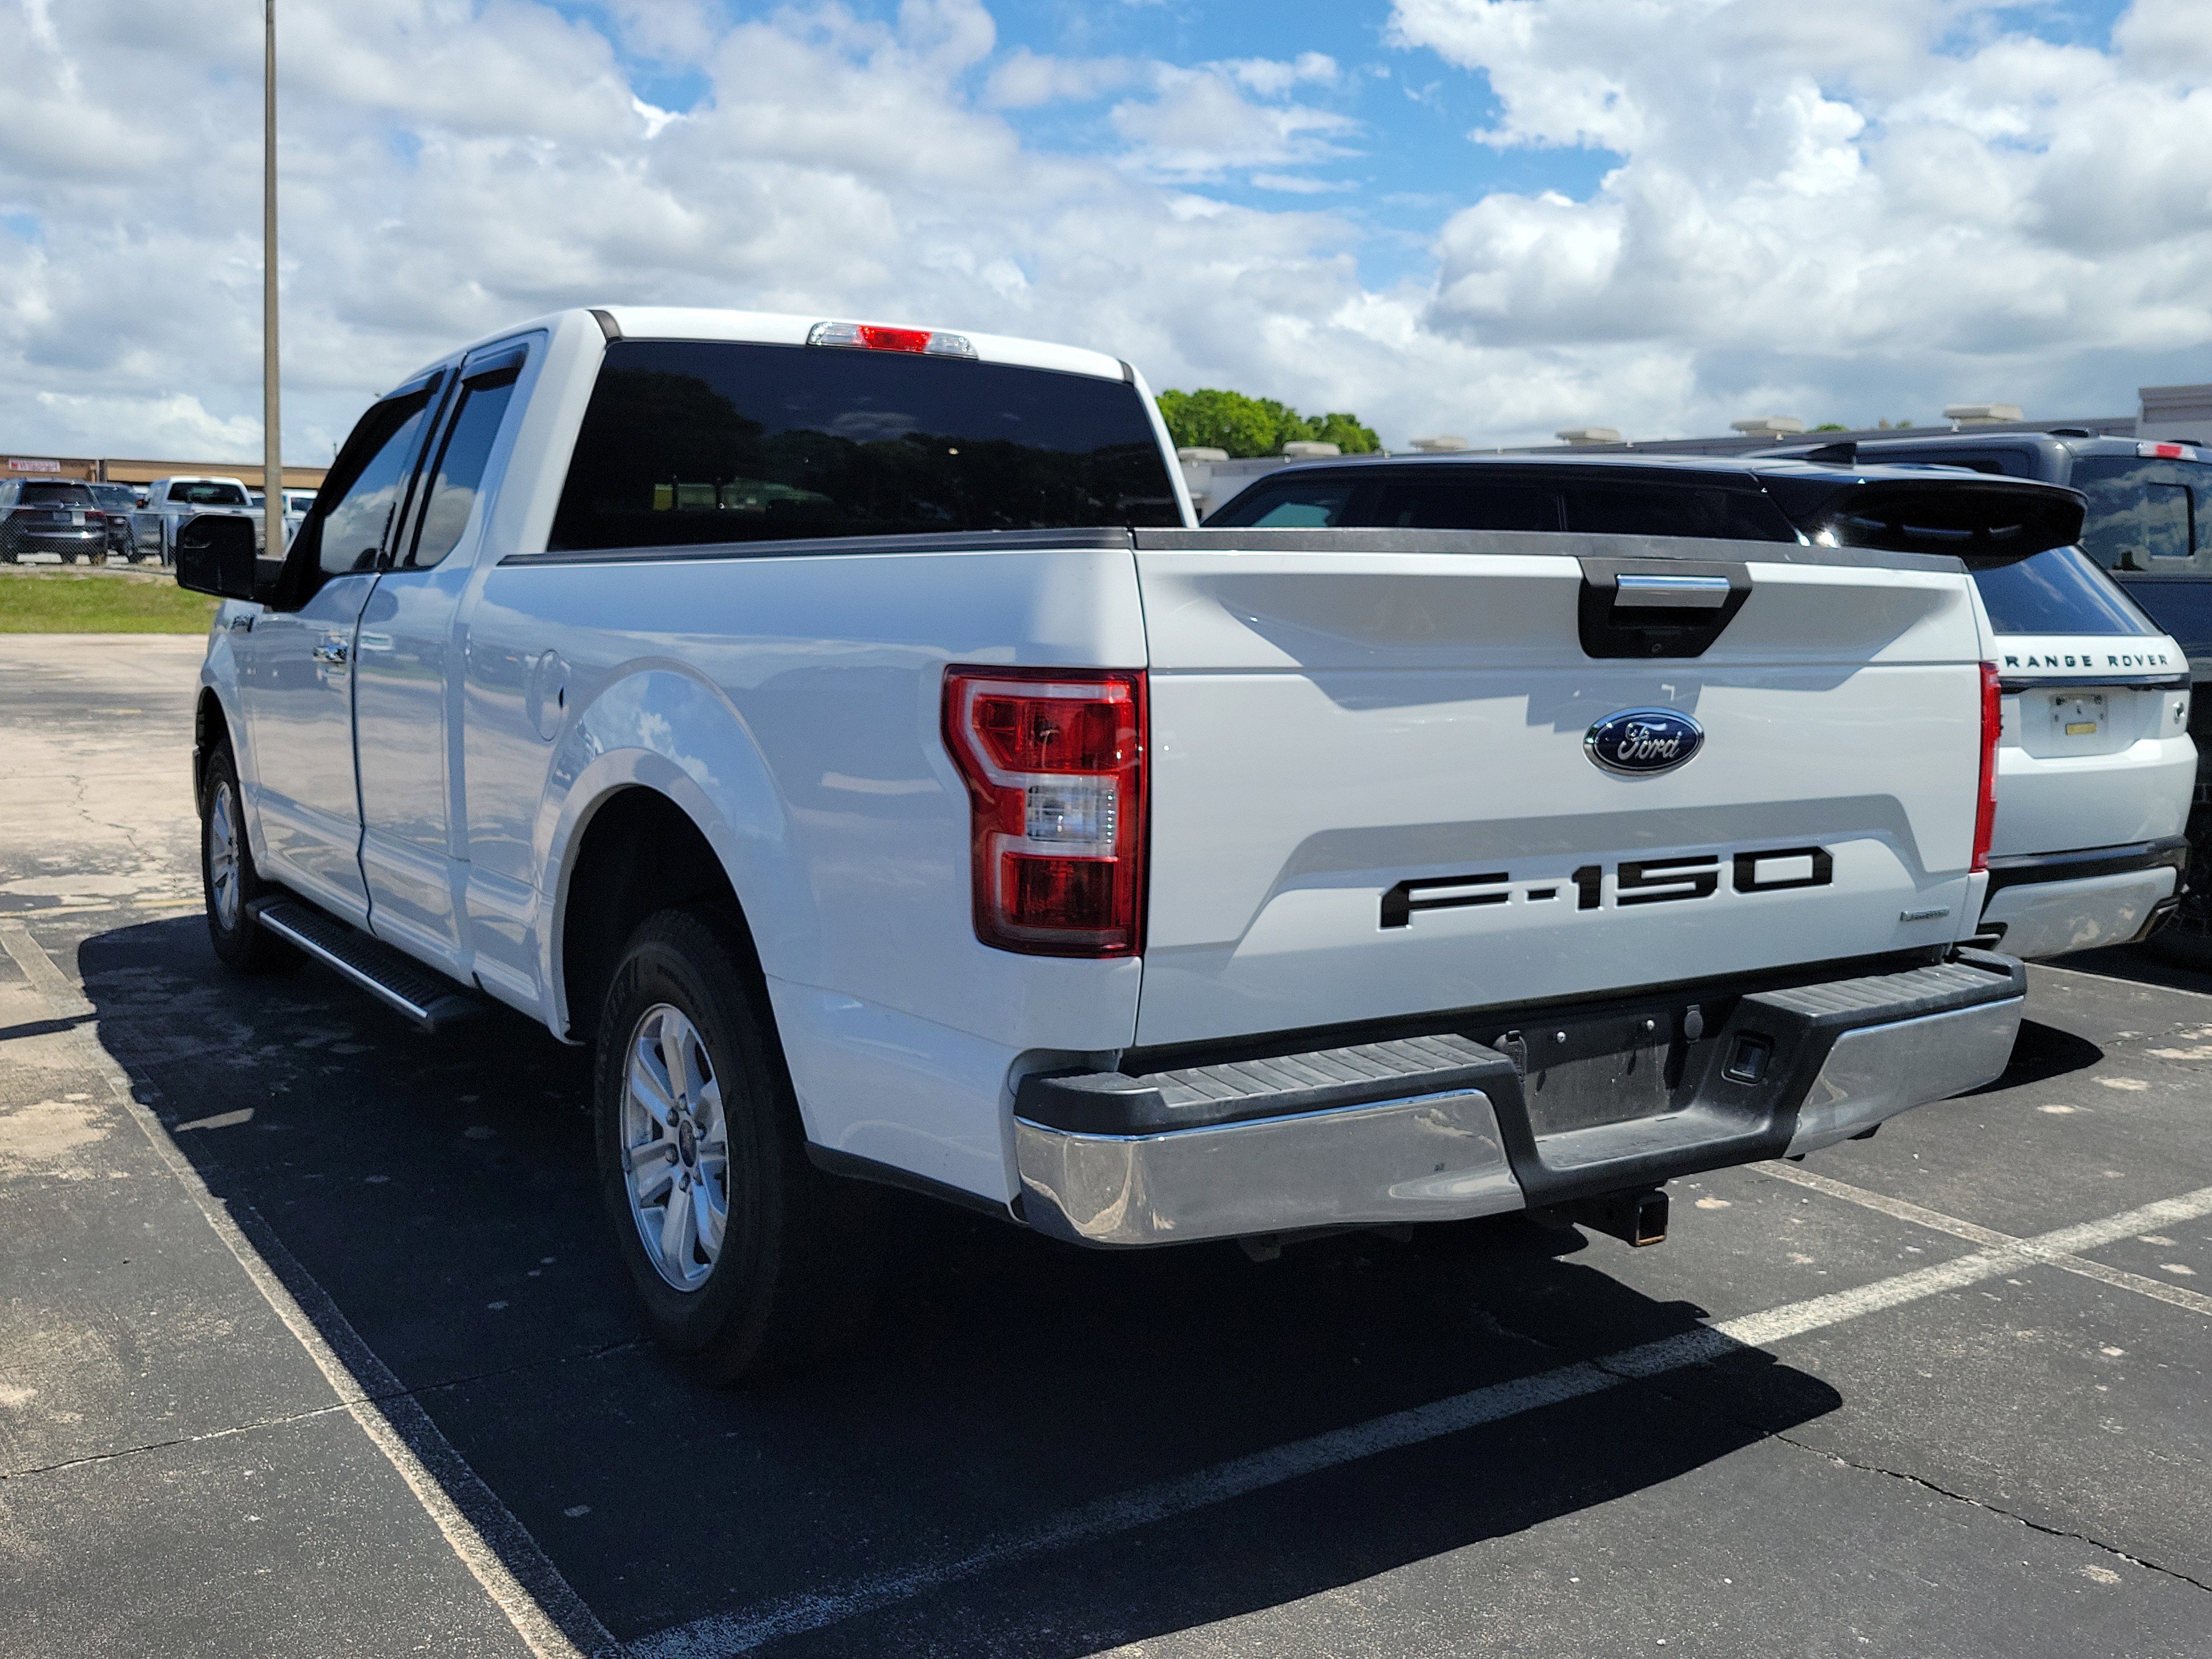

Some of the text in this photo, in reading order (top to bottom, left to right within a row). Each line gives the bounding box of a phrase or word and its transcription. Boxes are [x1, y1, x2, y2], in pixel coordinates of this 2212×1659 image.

[2004, 654, 2168, 668] RANGE ROVER
[1617, 721, 1683, 760] Ford
[1380, 845, 1833, 928] F-150
